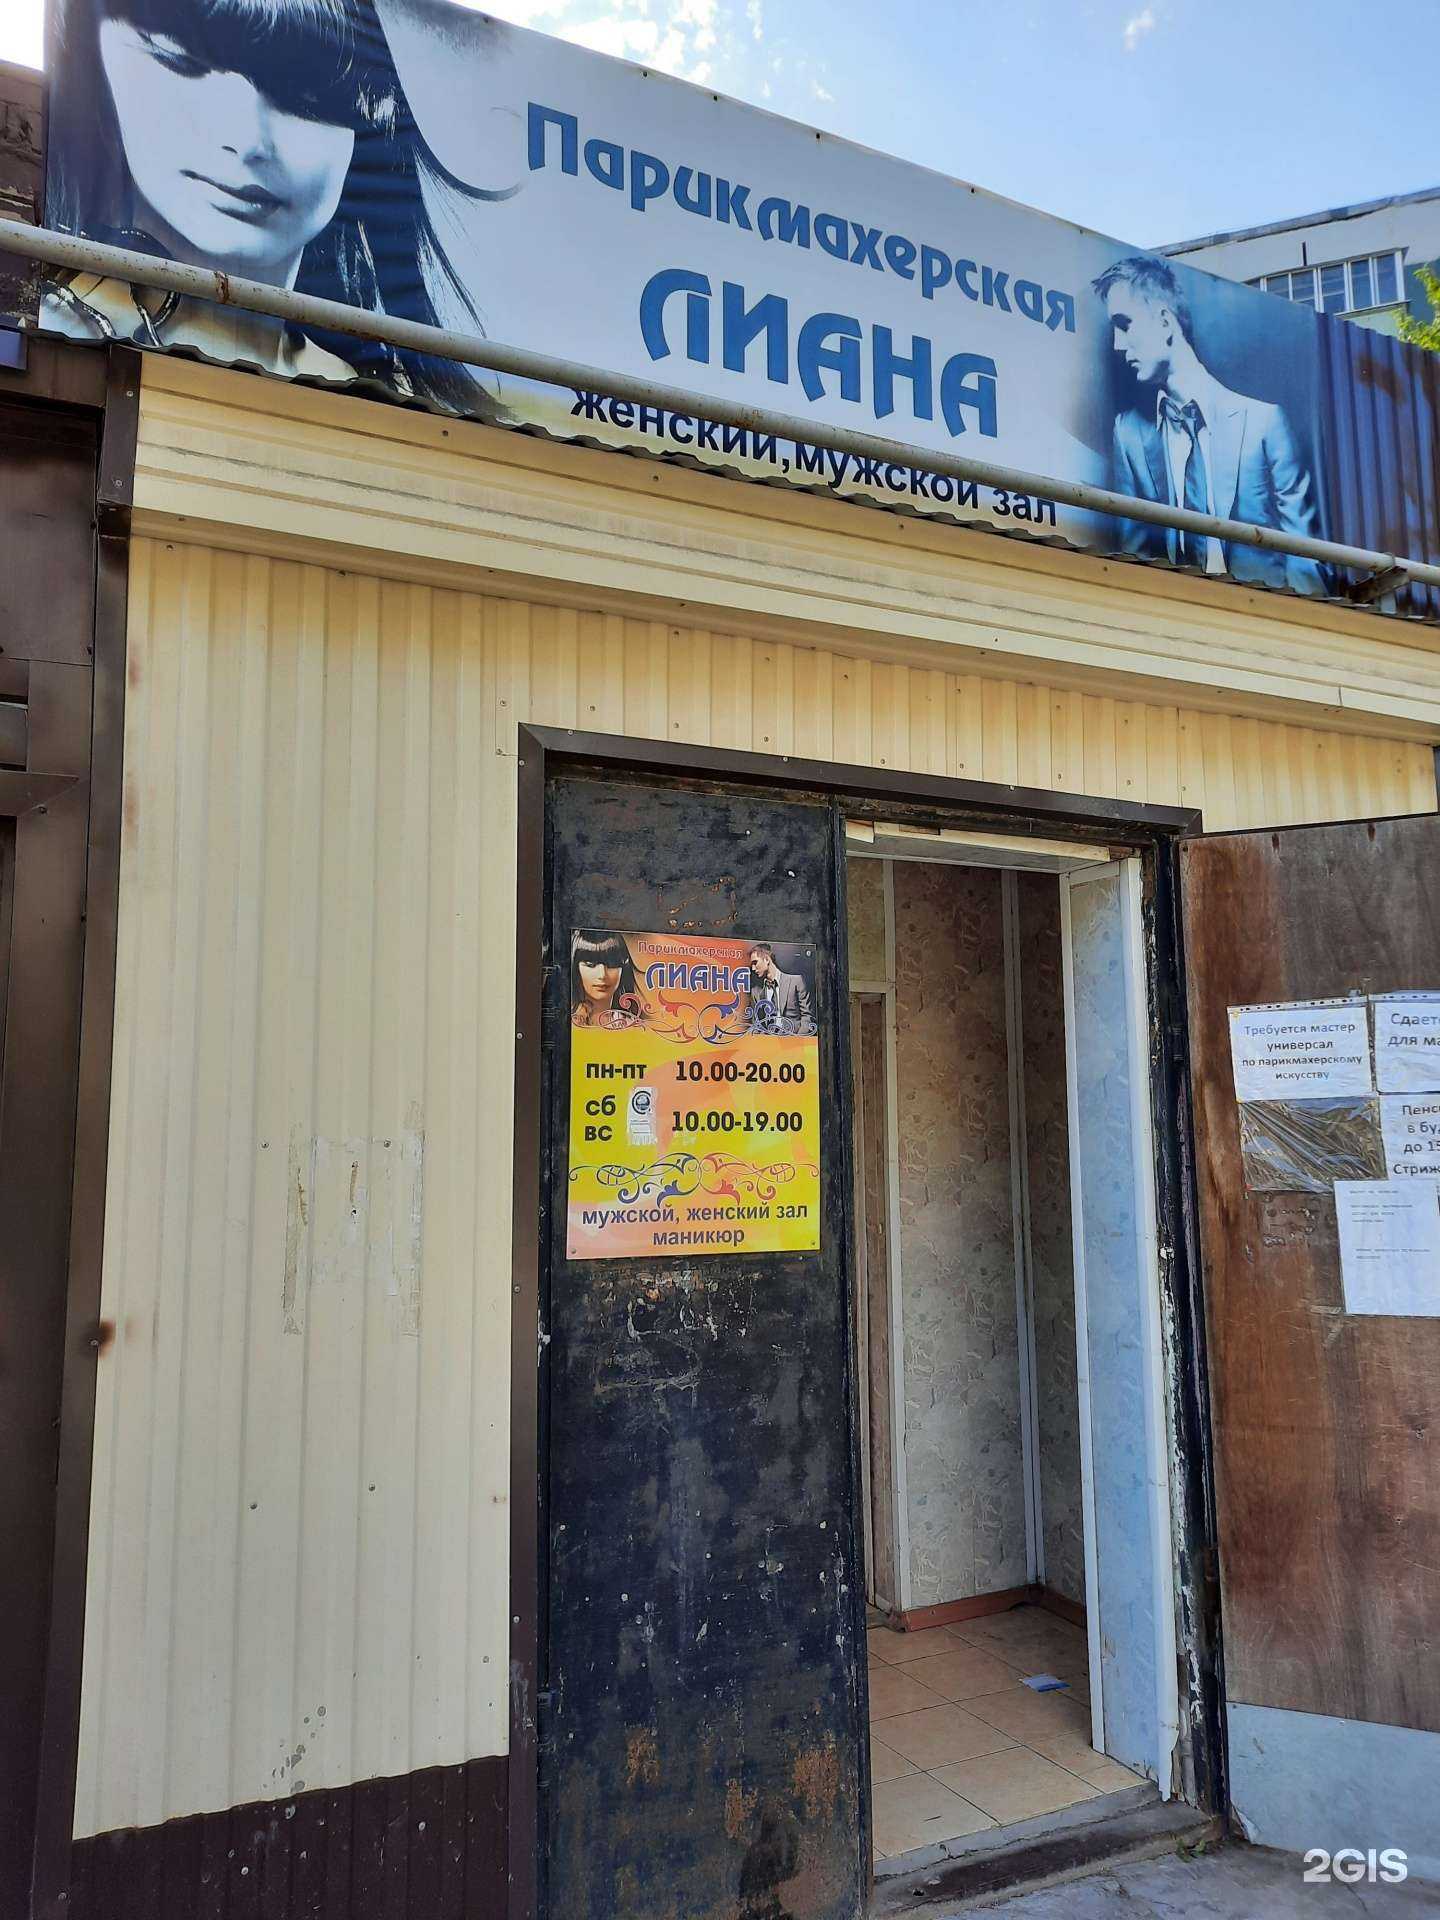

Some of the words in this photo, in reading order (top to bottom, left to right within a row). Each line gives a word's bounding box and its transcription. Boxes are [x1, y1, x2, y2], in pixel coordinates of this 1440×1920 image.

[527, 101, 1076, 333] Парикмахерская
[639, 268, 998, 439] ЛИАНА
[992, 488, 1057, 527] зал
[638, 940, 743, 959] Парикмахерская
[645, 961, 751, 994] ЛИАНА
[1391, 1013, 1440, 1027] Сдает
[1244, 1025, 1307, 1037] Требуется
[1310, 1023, 1356, 1033] мастер
[1267, 1040, 1334, 1052] универсал
[1387, 1036, 1417, 1047] для
[1242, 1058, 1255, 1067] по
[1258, 1056, 1363, 1067] парикмахерскому
[676, 1061, 805, 1083] 10.00-20.00
[1275, 1071, 1330, 1081] искусству
[585, 1095, 616, 1116] сб
[1402, 1104, 1440, 1115] Пенс
[672, 1111, 803, 1132] 10.00-19.00
[1420, 1121, 1440, 1135] бу
[1403, 1143, 1422, 1154] до
[582, 1204, 680, 1228] мужской,
[686, 1202, 770, 1221] женский
[776, 1204, 808, 1219] зал
[653, 1227, 745, 1246] маникюр
